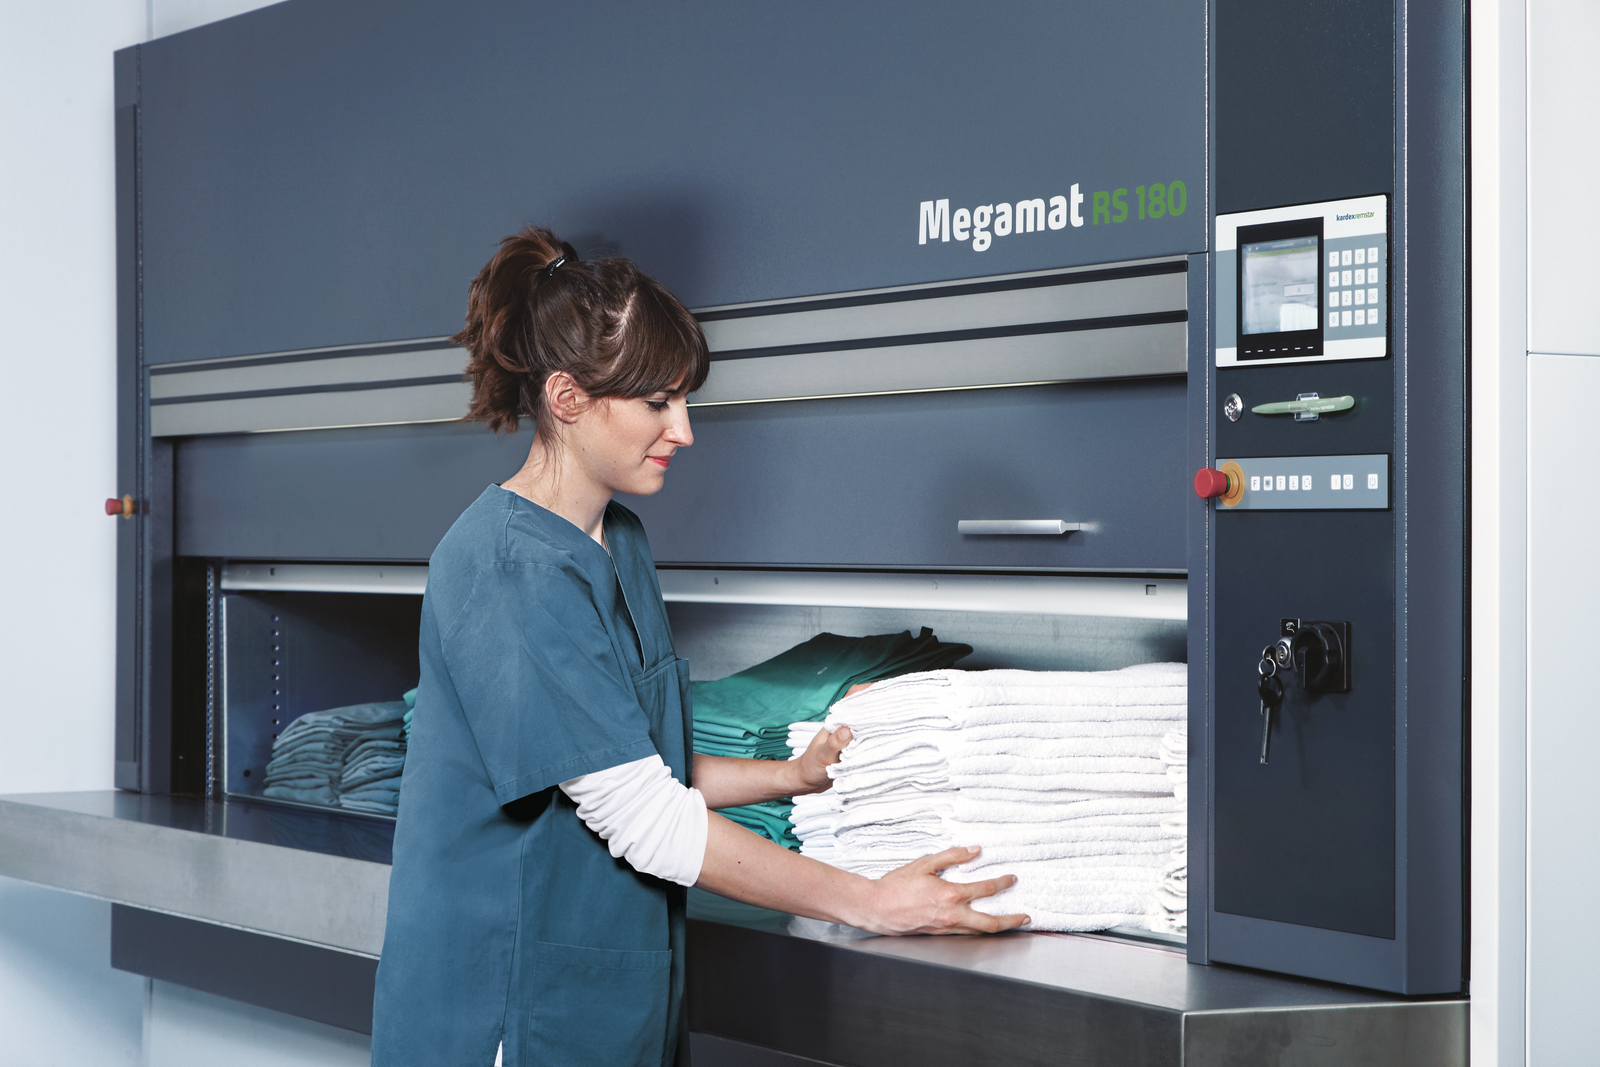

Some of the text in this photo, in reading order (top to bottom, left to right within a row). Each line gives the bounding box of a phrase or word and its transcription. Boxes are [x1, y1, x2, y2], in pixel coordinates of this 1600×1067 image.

[919, 180, 1187, 252] Megamat RS 180
